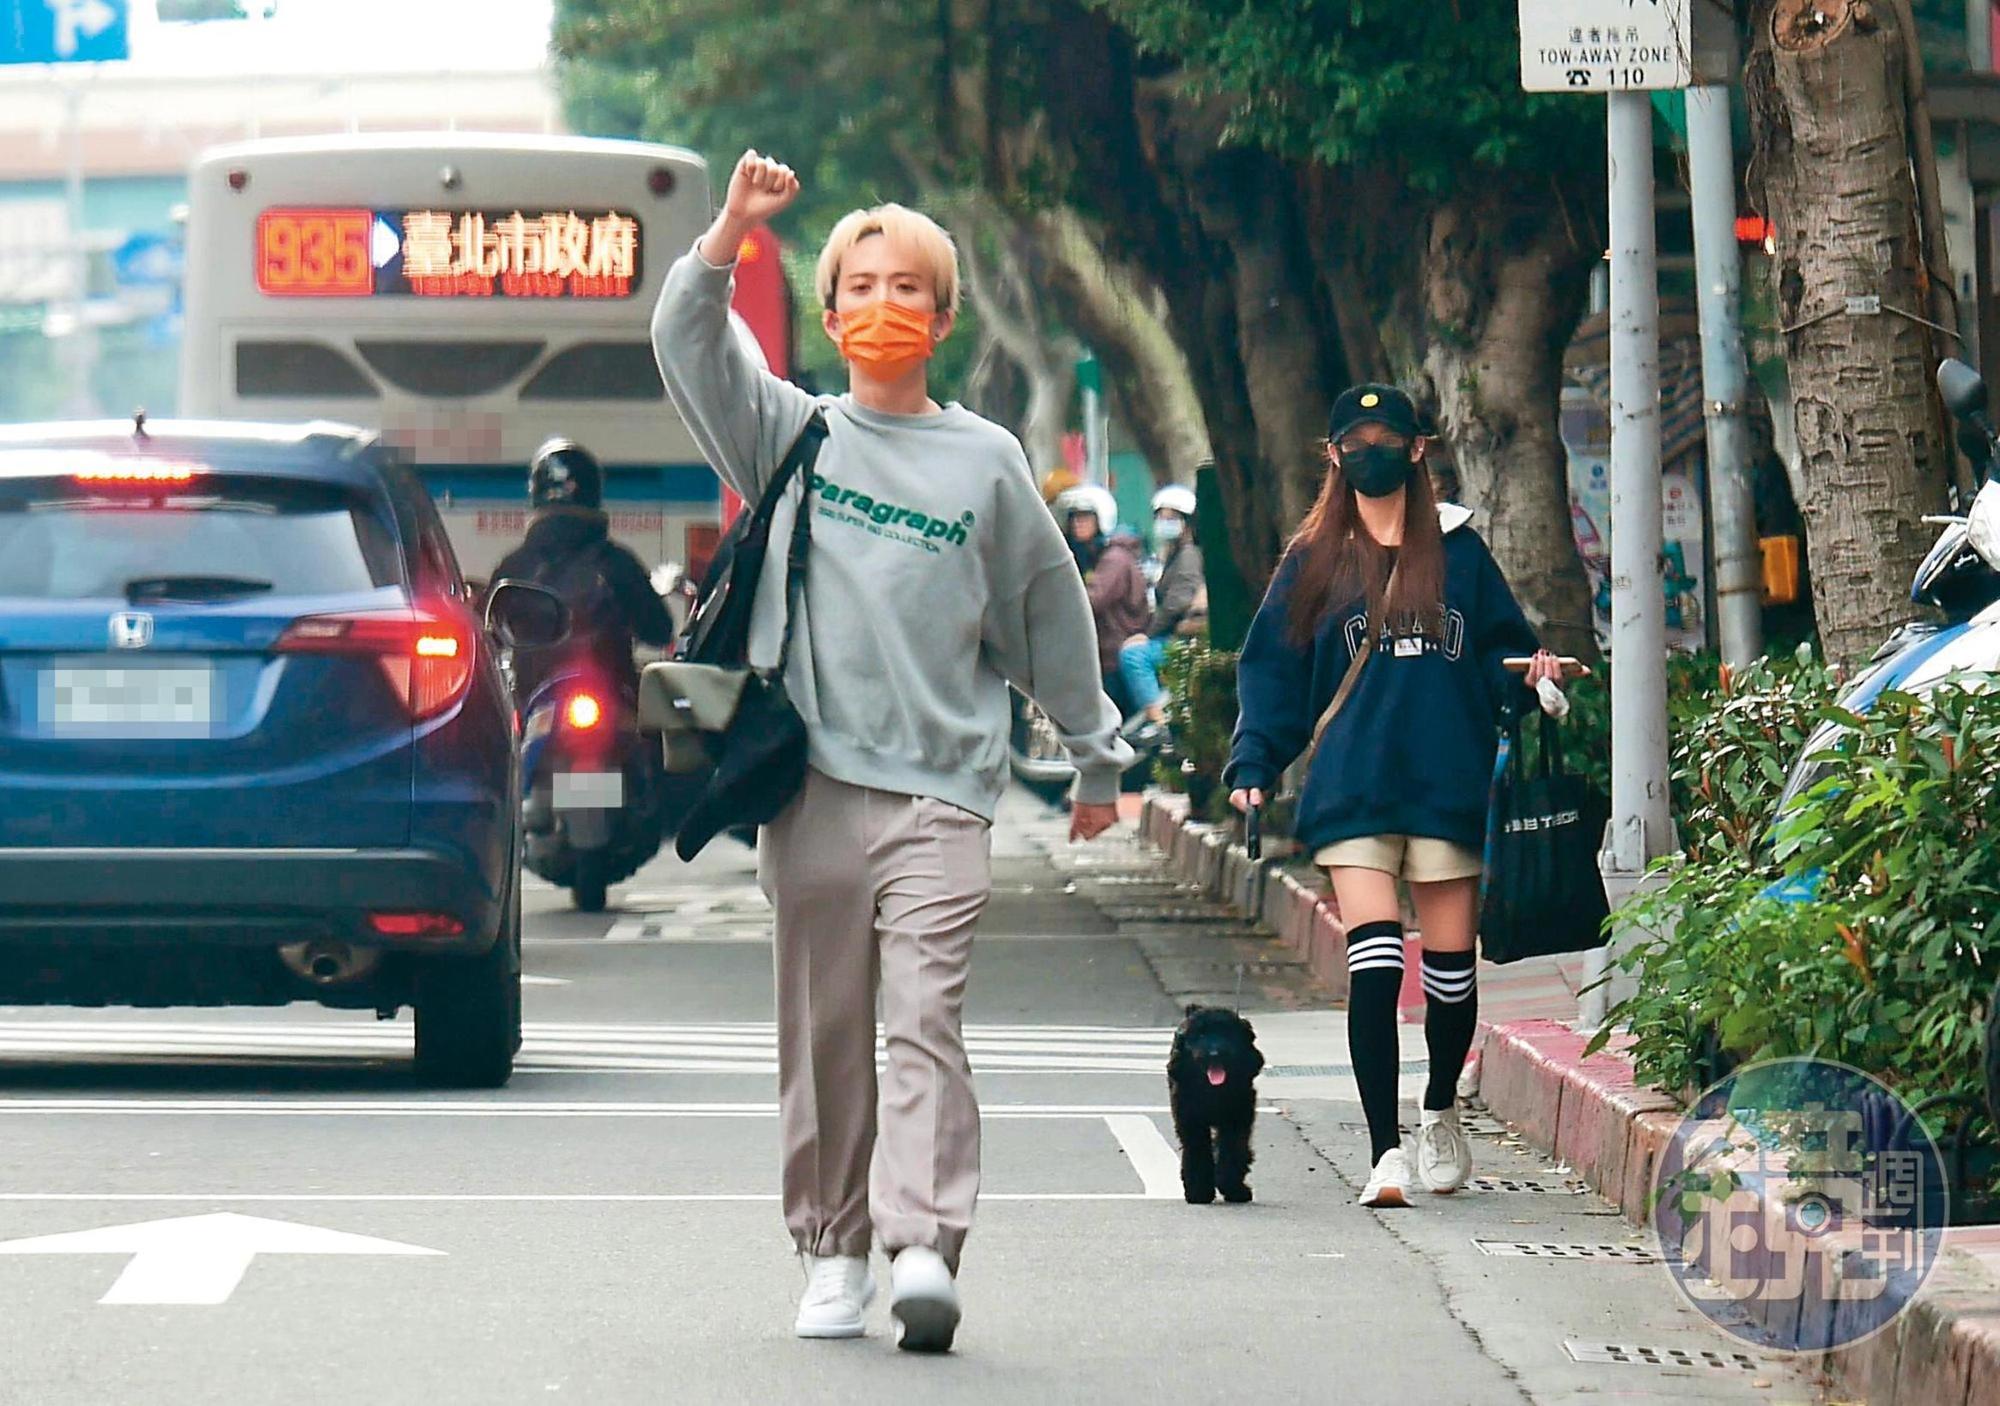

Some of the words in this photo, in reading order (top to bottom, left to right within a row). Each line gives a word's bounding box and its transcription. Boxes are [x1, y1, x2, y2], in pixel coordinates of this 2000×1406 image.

[1629, 46, 1672, 63] ZONE
[1609, 68, 1645, 86] 110
[267, 216, 369, 286] 935
[402, 209, 638, 279] 臺北市政府
